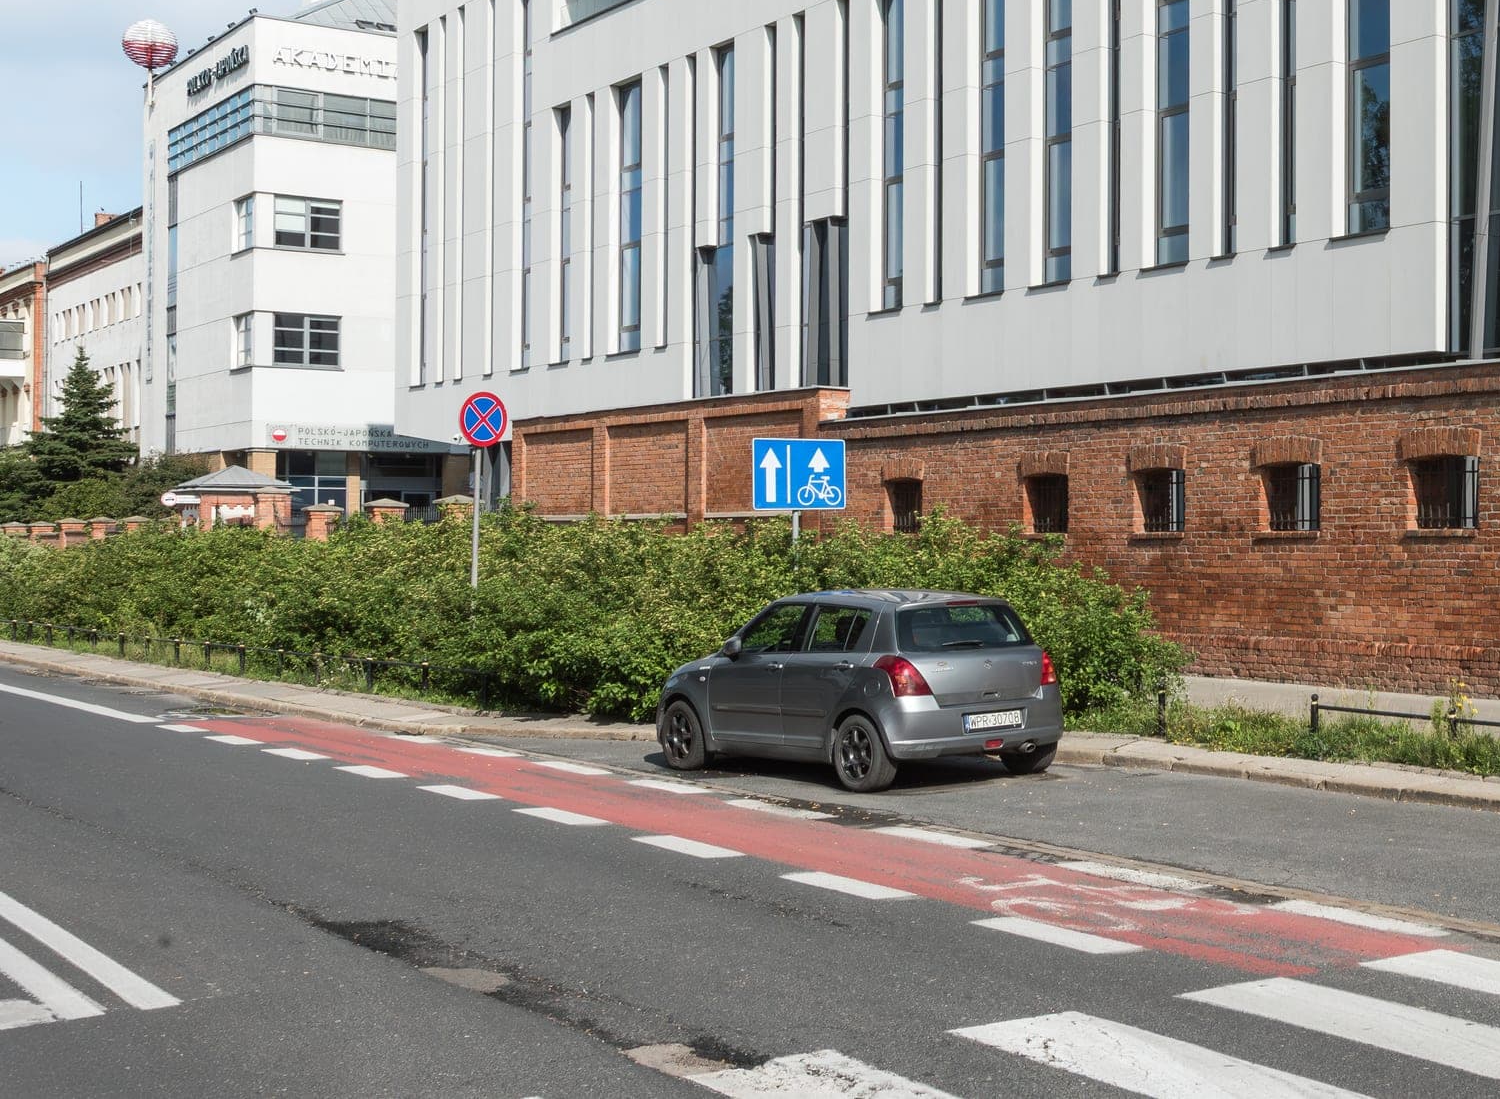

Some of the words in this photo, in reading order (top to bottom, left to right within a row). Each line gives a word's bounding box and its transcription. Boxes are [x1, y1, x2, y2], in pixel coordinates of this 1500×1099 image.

[273, 47, 398, 80] AKADEMI
[298, 437, 342, 447] TECHNIK
[349, 438, 429, 449] KOMPUTEROWYCH
[969, 715, 989, 729] WPR
[991, 711, 1020, 726] 30708
